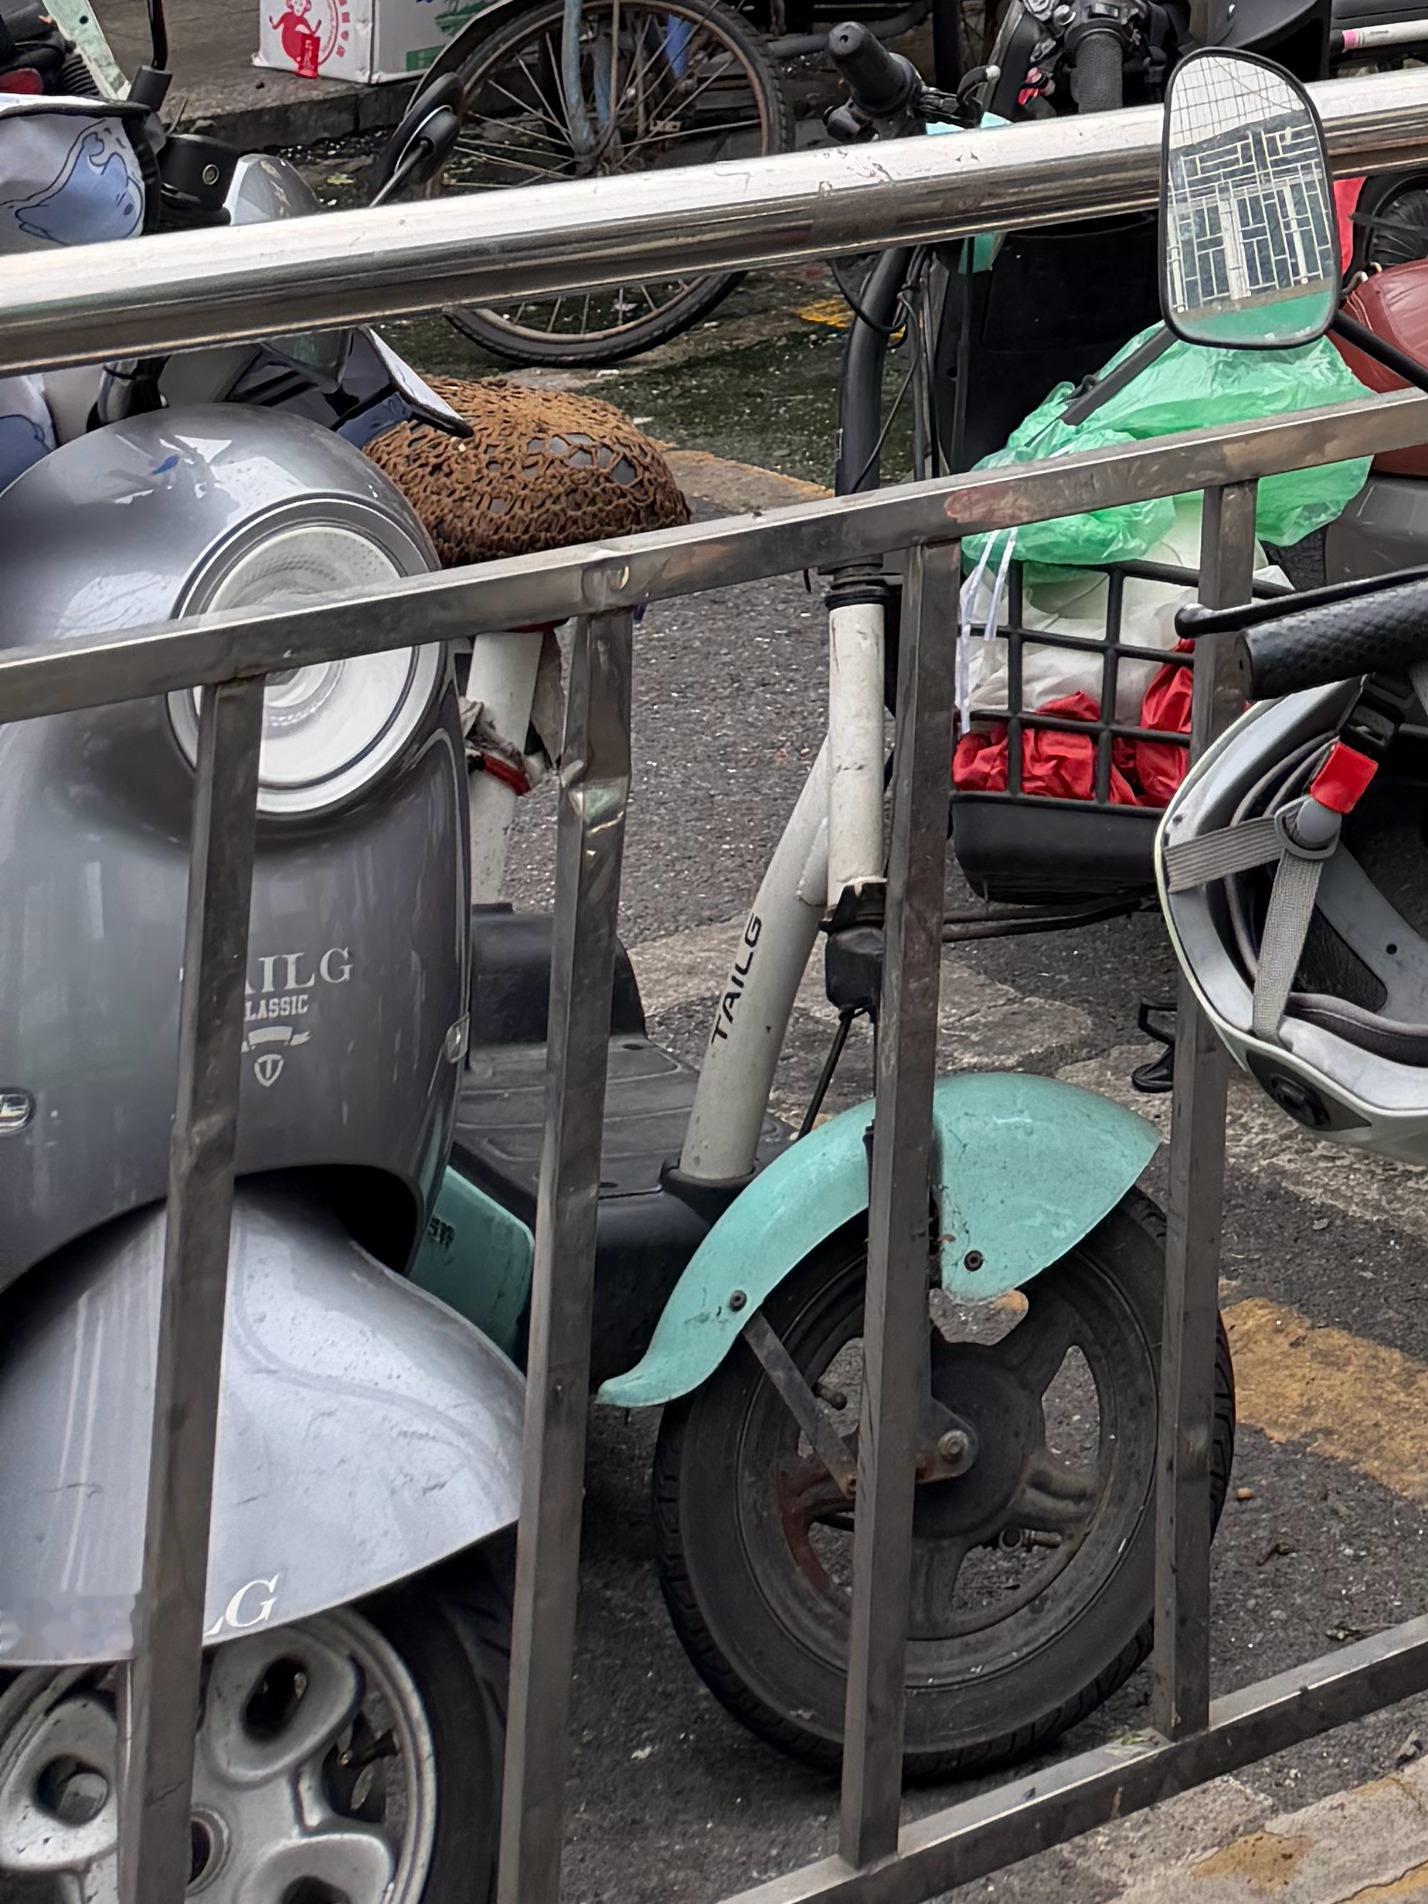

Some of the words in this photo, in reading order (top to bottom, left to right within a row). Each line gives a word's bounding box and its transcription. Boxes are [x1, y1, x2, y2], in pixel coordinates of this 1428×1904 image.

[244, 945, 353, 994] ILG
[710, 913, 763, 1046] TAILG
[245, 993, 309, 1021] LASSIC
